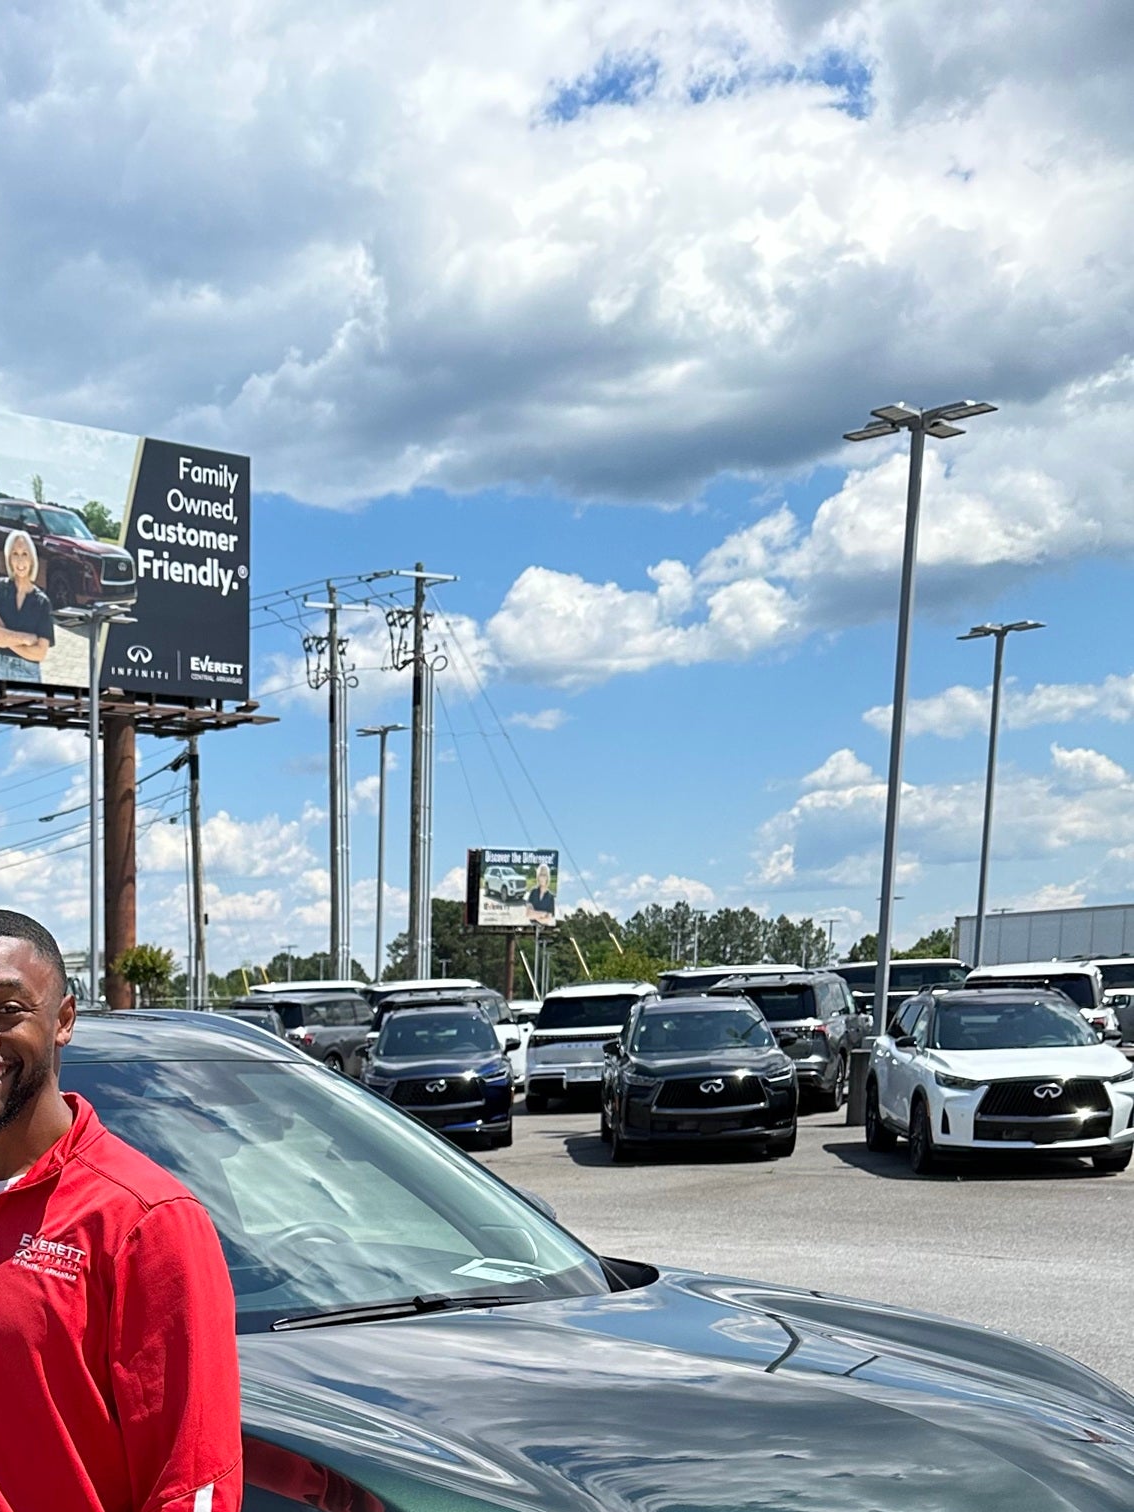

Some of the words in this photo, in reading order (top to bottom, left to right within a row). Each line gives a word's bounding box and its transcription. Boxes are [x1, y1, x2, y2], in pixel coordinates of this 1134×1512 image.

[179, 456, 238, 494] Family
[167, 488, 238, 525] Owned,
[137, 513, 238, 552] Customer
[111, 666, 169, 680] INFINITI
[190, 655, 243, 675] EVERETT
[484, 850, 510, 863] Discover
[511, 851, 522, 864] the
[19, 1232, 87, 1262] EVERETT
